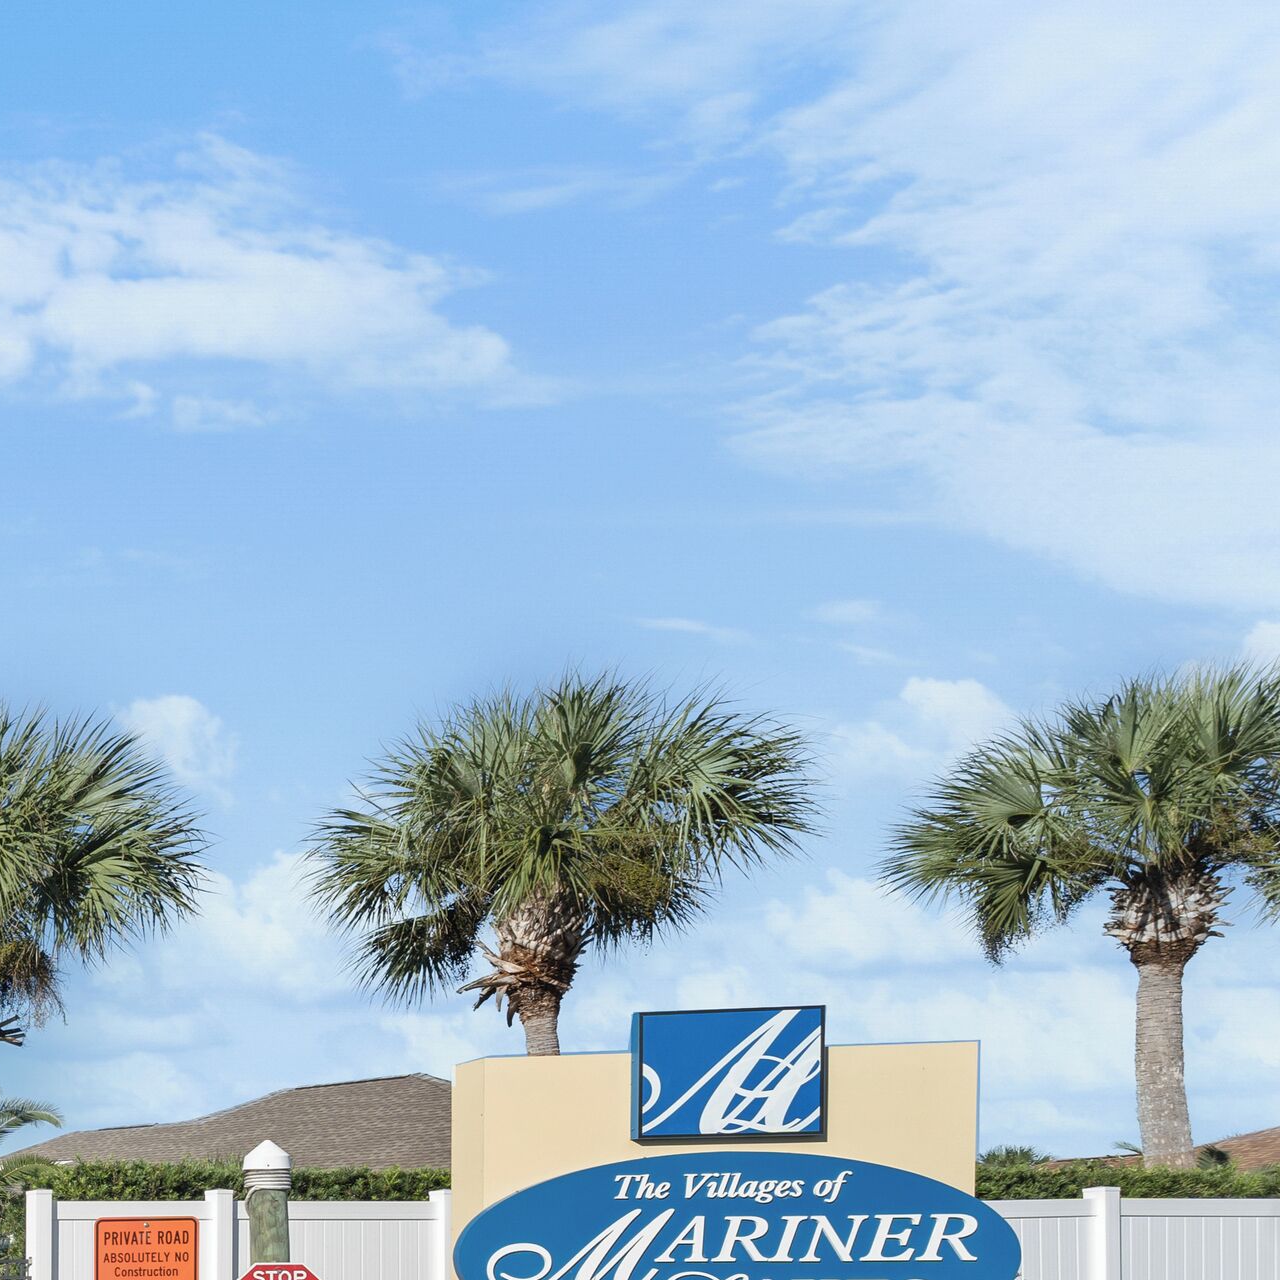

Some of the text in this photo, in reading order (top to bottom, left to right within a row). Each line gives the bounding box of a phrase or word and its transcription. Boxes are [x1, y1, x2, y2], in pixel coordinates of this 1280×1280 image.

[614, 1170, 853, 1203] The Villages of
[104, 1230, 189, 1245] PRIVATE ROAD
[103, 1251, 189, 1263] ABSOLUTELY NO
[114, 1266, 179, 1277] Construction
